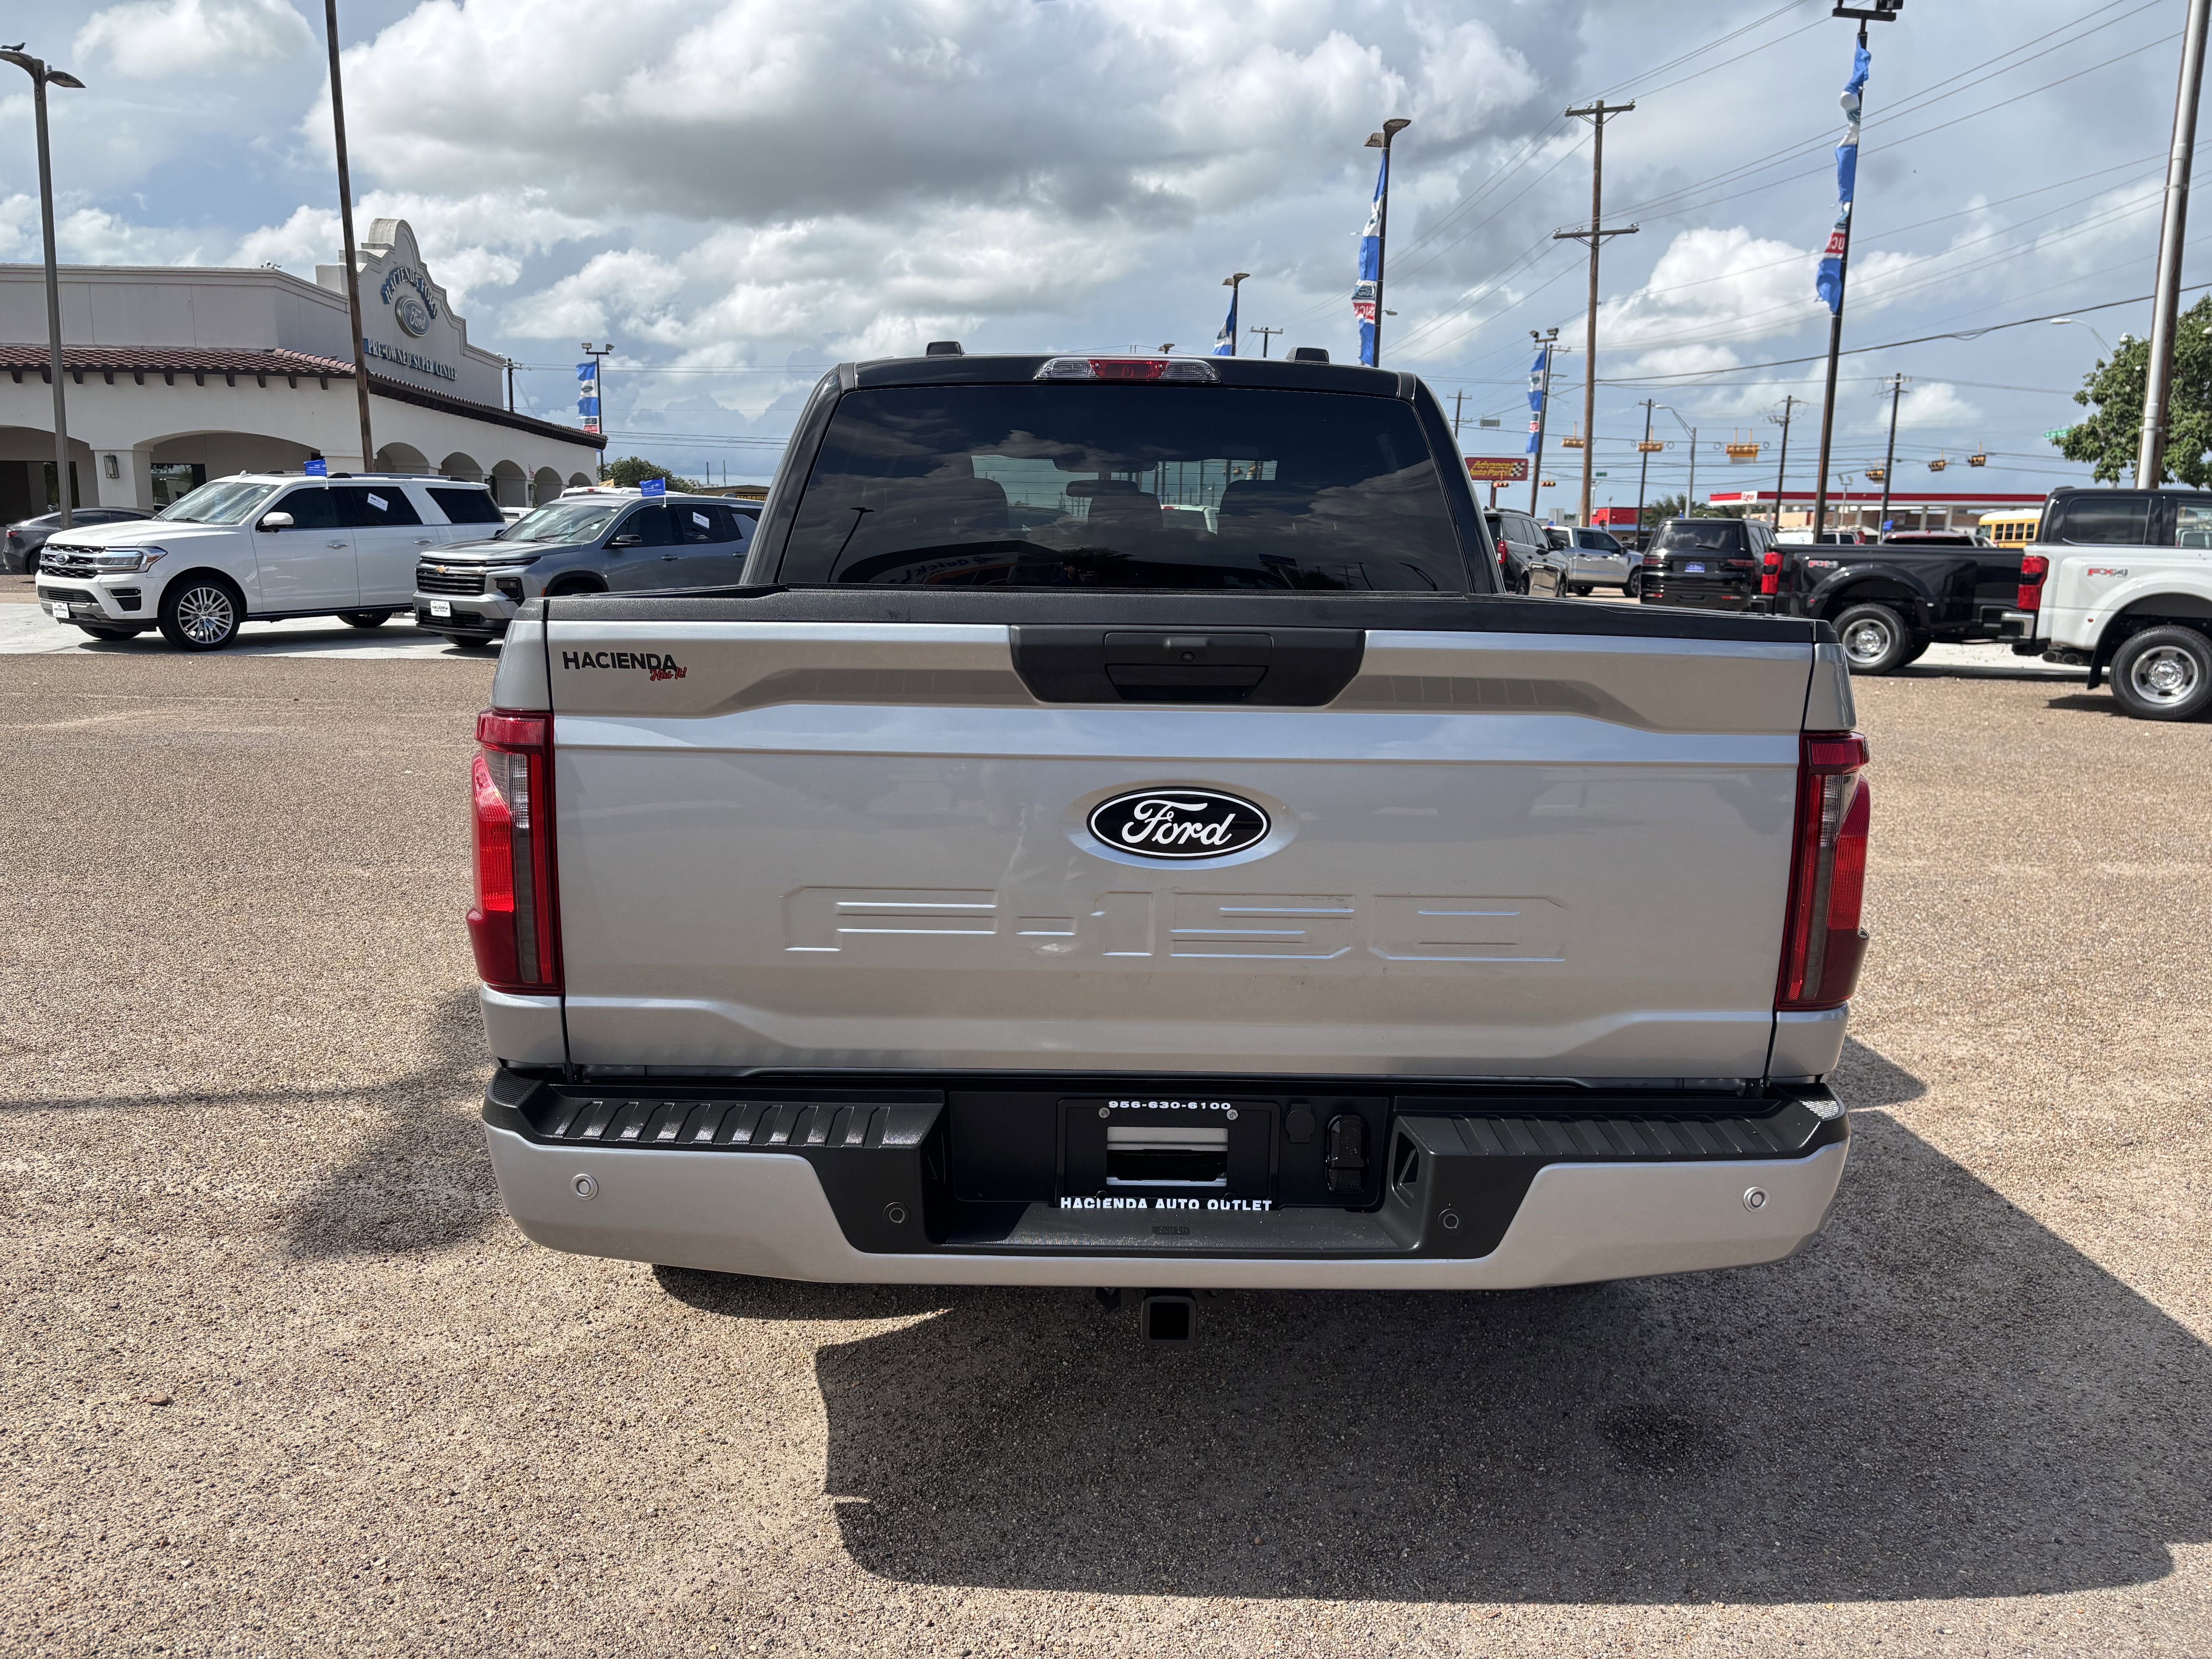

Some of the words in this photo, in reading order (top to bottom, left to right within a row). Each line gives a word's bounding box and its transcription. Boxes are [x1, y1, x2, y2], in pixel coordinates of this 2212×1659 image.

[410, 306, 426, 330] Ford
[368, 338, 412, 366] PRE-OWNED
[414, 354, 435, 373] SUPER
[436, 362, 458, 381] CENTER
[2087, 568, 2128, 577] FX4
[562, 651, 677, 672] HACIENDA
[649, 668, 674, 681] Has
[1121, 799, 1236, 845] Ford
[779, 886, 1569, 963] F-150
[1108, 1100, 1231, 1110] 956-630-6100
[1060, 1197, 1147, 1209] HACIENDA
[1155, 1199, 1200, 1210] AUTO
[1207, 1200, 1272, 1211] OUTLET
